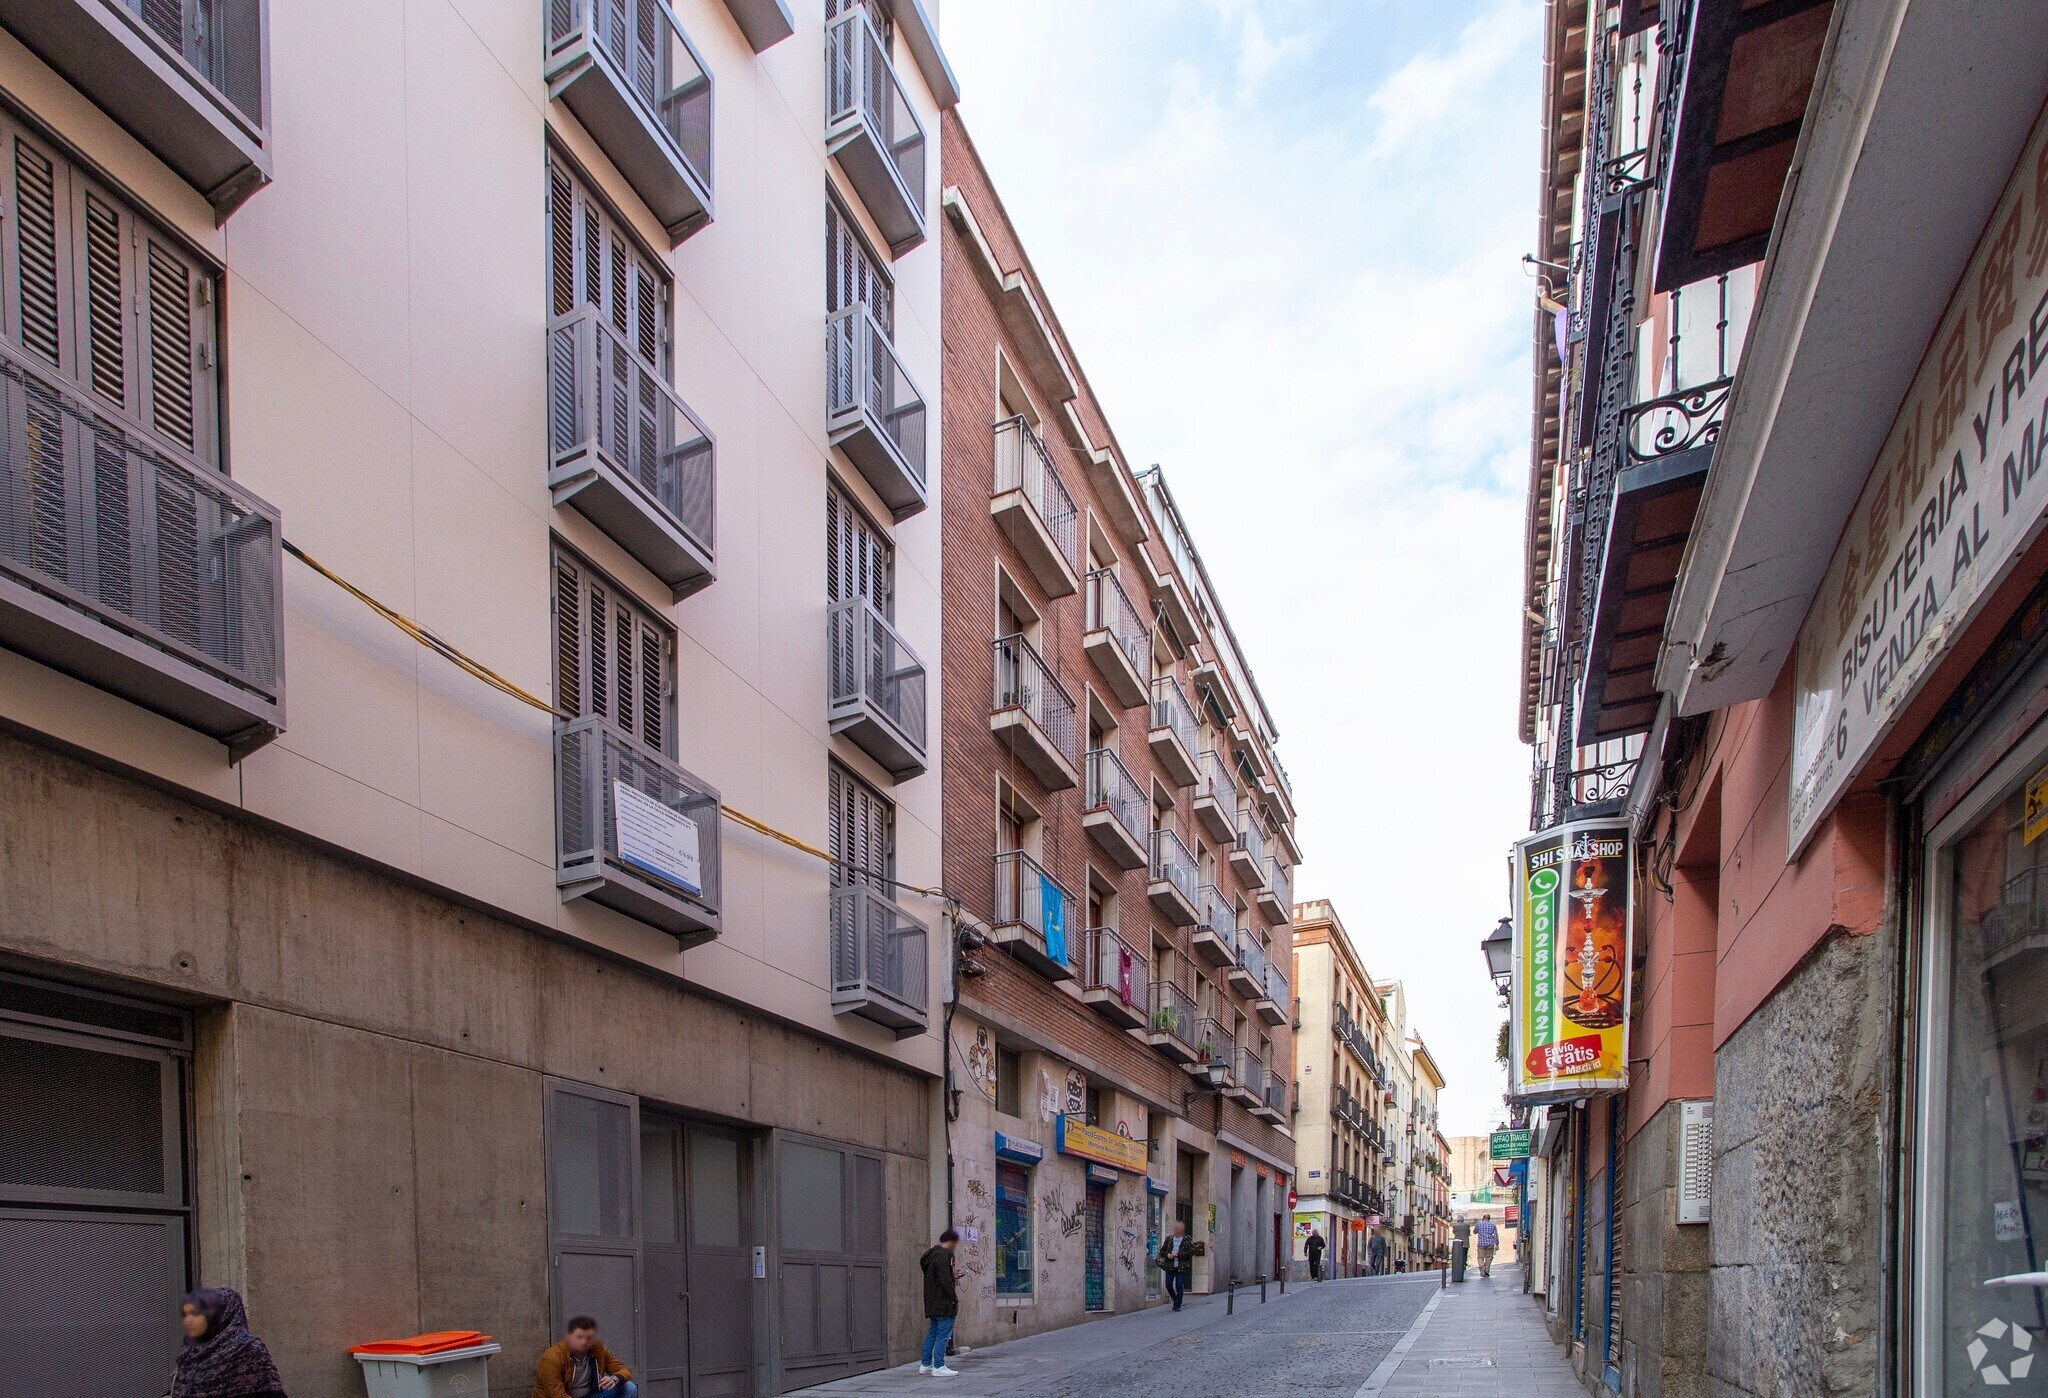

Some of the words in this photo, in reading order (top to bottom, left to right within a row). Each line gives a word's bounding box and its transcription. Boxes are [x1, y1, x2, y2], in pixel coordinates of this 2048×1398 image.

[1841, 449, 1968, 700] BISUTERIA
[1972, 383, 1996, 464] Y
[1863, 575, 1938, 716] VENTA
[1951, 501, 1989, 592] AL
[1837, 708, 1848, 761] 6
[1531, 850, 1553, 869] SHI
[1556, 844, 1581, 862] SHA
[1591, 842, 1624, 857] SHOP
[1544, 1042, 1574, 1058] Envío
[1545, 1047, 1595, 1075] gratis
[1493, 1134, 1510, 1143] AFFAQ
